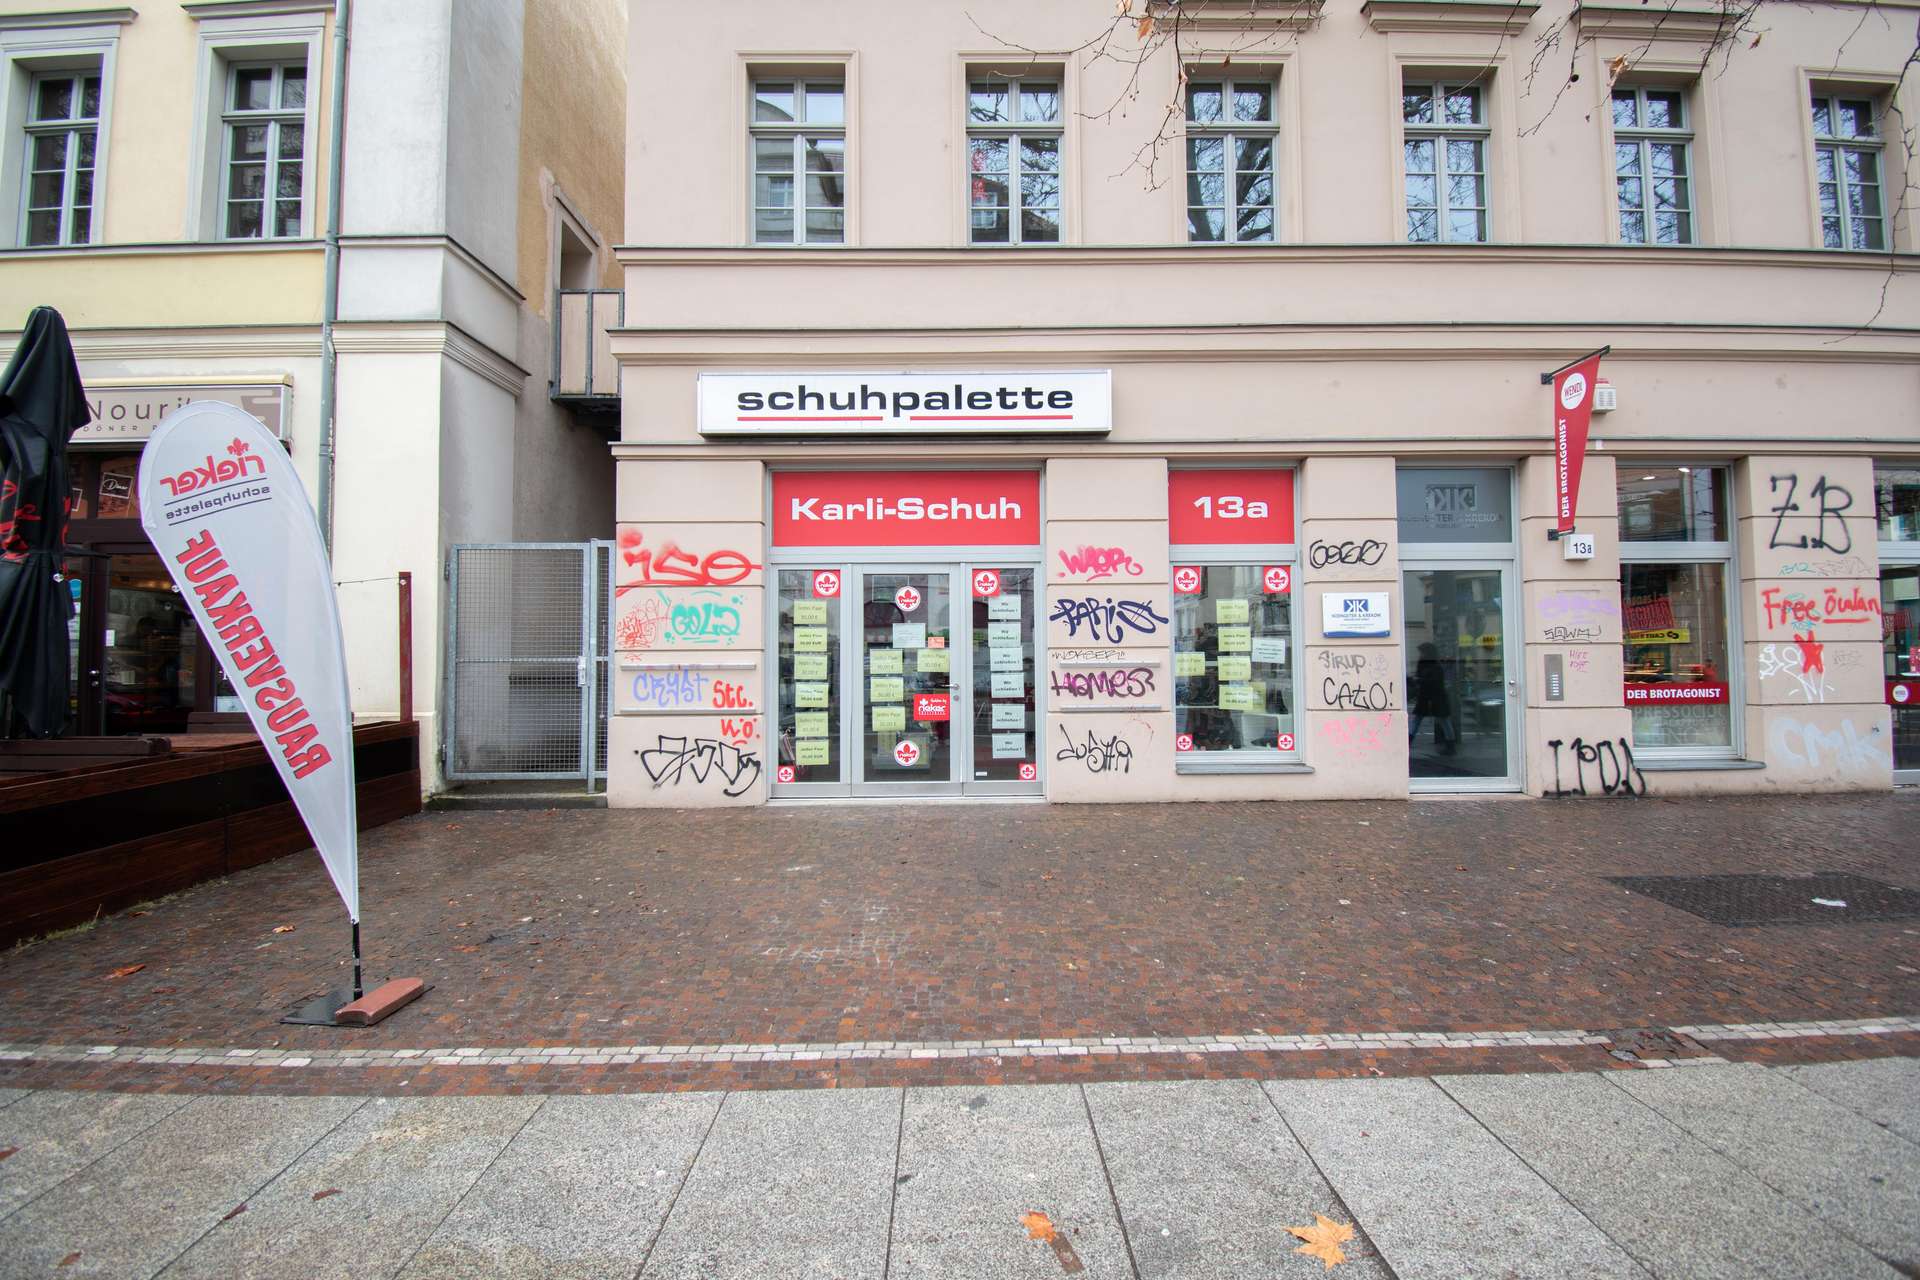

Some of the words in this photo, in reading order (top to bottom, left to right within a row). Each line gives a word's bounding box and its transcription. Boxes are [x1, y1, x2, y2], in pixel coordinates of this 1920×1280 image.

[737, 384, 1074, 417] schuhpalette
[1559, 418, 1568, 494] BROTAGONIST
[790, 496, 1022, 521] Karli-Schuh
[1193, 496, 1269, 519] 13a
[1561, 496, 1570, 518] DER
[1573, 542, 1593, 554] 13a
[1761, 587, 1821, 630] Free
[1627, 690, 1648, 699] DER
[1649, 688, 1721, 699] BROTAGONIST
